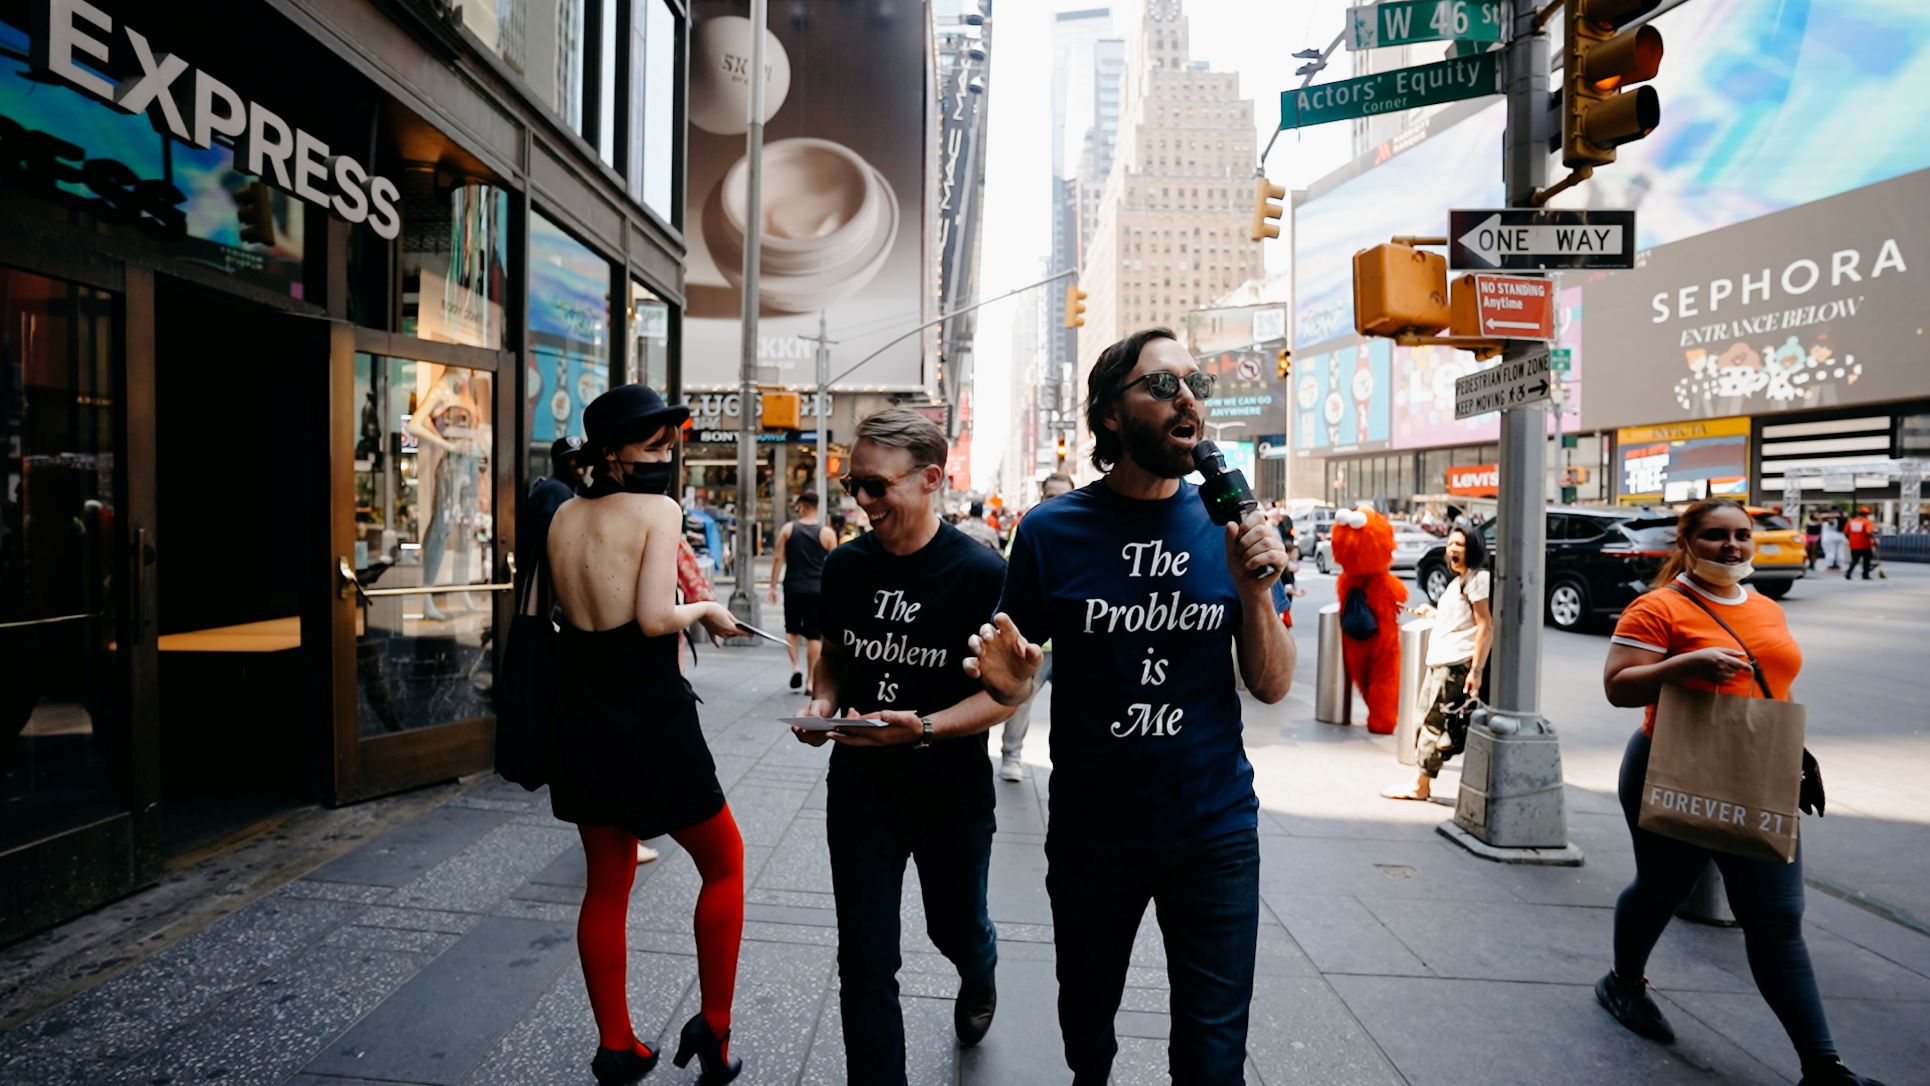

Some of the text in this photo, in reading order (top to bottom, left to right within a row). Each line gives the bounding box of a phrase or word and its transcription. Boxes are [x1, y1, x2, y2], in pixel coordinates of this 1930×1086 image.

[1385, 0, 1498, 40] W 46 St
[1297, 60, 1481, 112] Actors' Equity
[49, 0, 400, 240] EXPRESS
[1362, 97, 1408, 114] Corner
[1478, 229, 1611, 251] ONE WAY
[1481, 282, 1545, 297] NO STANDING
[1651, 238, 1907, 324] SEPHORA
[1484, 296, 1523, 310] Anytime
[1680, 296, 1865, 346] ENTRANCE BELOW
[757, 337, 811, 359] KKN
[1456, 370, 1501, 396] PEDESTRIAN
[1503, 363, 1524, 383] FLOW
[1527, 355, 1548, 376] ZONE
[1210, 406, 1262, 416] ANYWHERE
[1238, 397, 1256, 405] CAN
[1257, 395, 1272, 404] GO
[1456, 391, 1505, 416] KEEP MOVING
[1122, 540, 1190, 577] The
[874, 590, 921, 623] The
[1083, 591, 1225, 633] Problem
[843, 629, 947, 668] Problem
[1141, 647, 1169, 685] is
[877, 672, 899, 702] is
[1110, 703, 1184, 737] Me
[1650, 788, 1783, 833] FOREVER 21
